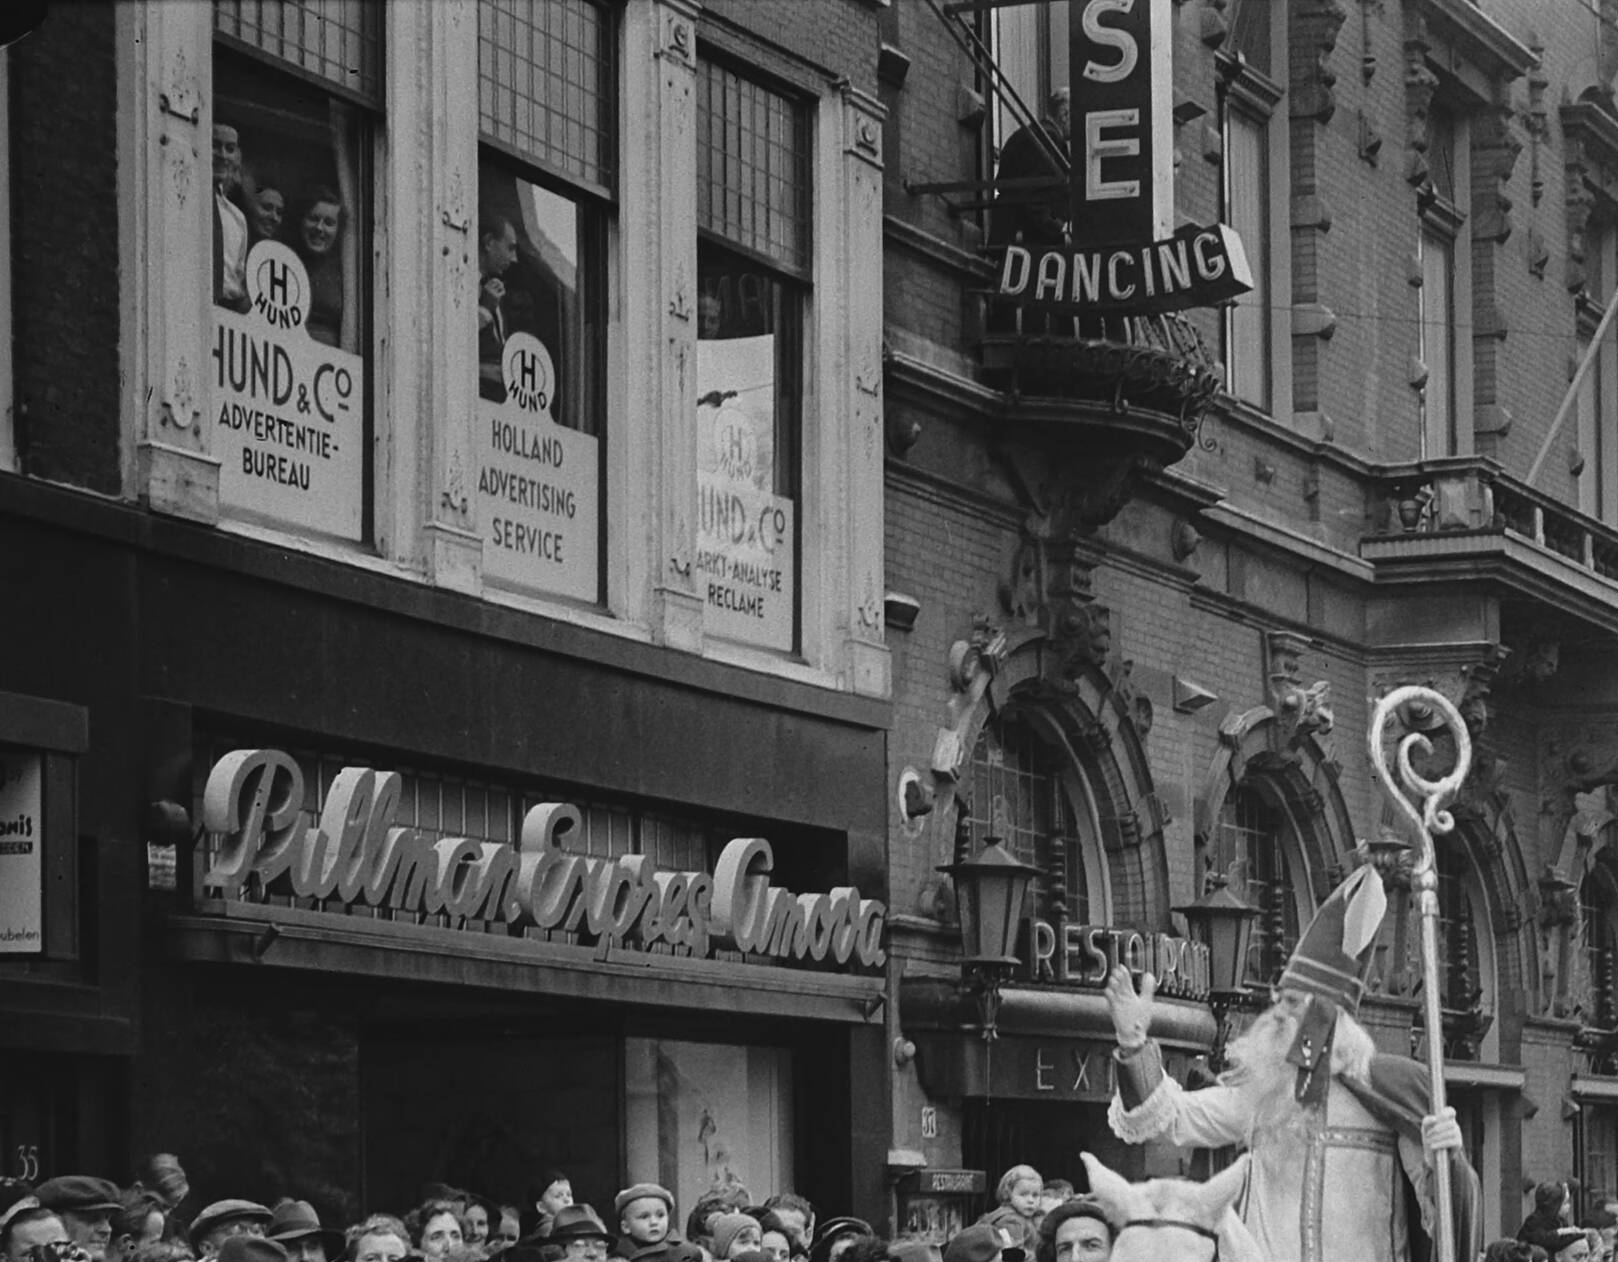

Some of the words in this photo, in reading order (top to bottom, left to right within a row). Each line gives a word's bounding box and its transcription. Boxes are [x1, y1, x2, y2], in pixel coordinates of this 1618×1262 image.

[269, 258, 287, 306] H
[1000, 231, 1226, 302] DANCING
[254, 291, 302, 330] HUND
[520, 349, 536, 392] H
[297, 382, 311, 415] &
[508, 379, 548, 412] HUND
[218, 401, 340, 460] ADVERTENTIE-
[492, 418, 564, 468] HOLLAND
[242, 446, 311, 491] BUREAU
[478, 466, 577, 519] ADVERTISING
[492, 516, 564, 564] SERVICE
[707, 582, 765, 619] RECLAME
[204, 749, 522, 924] Pullman
